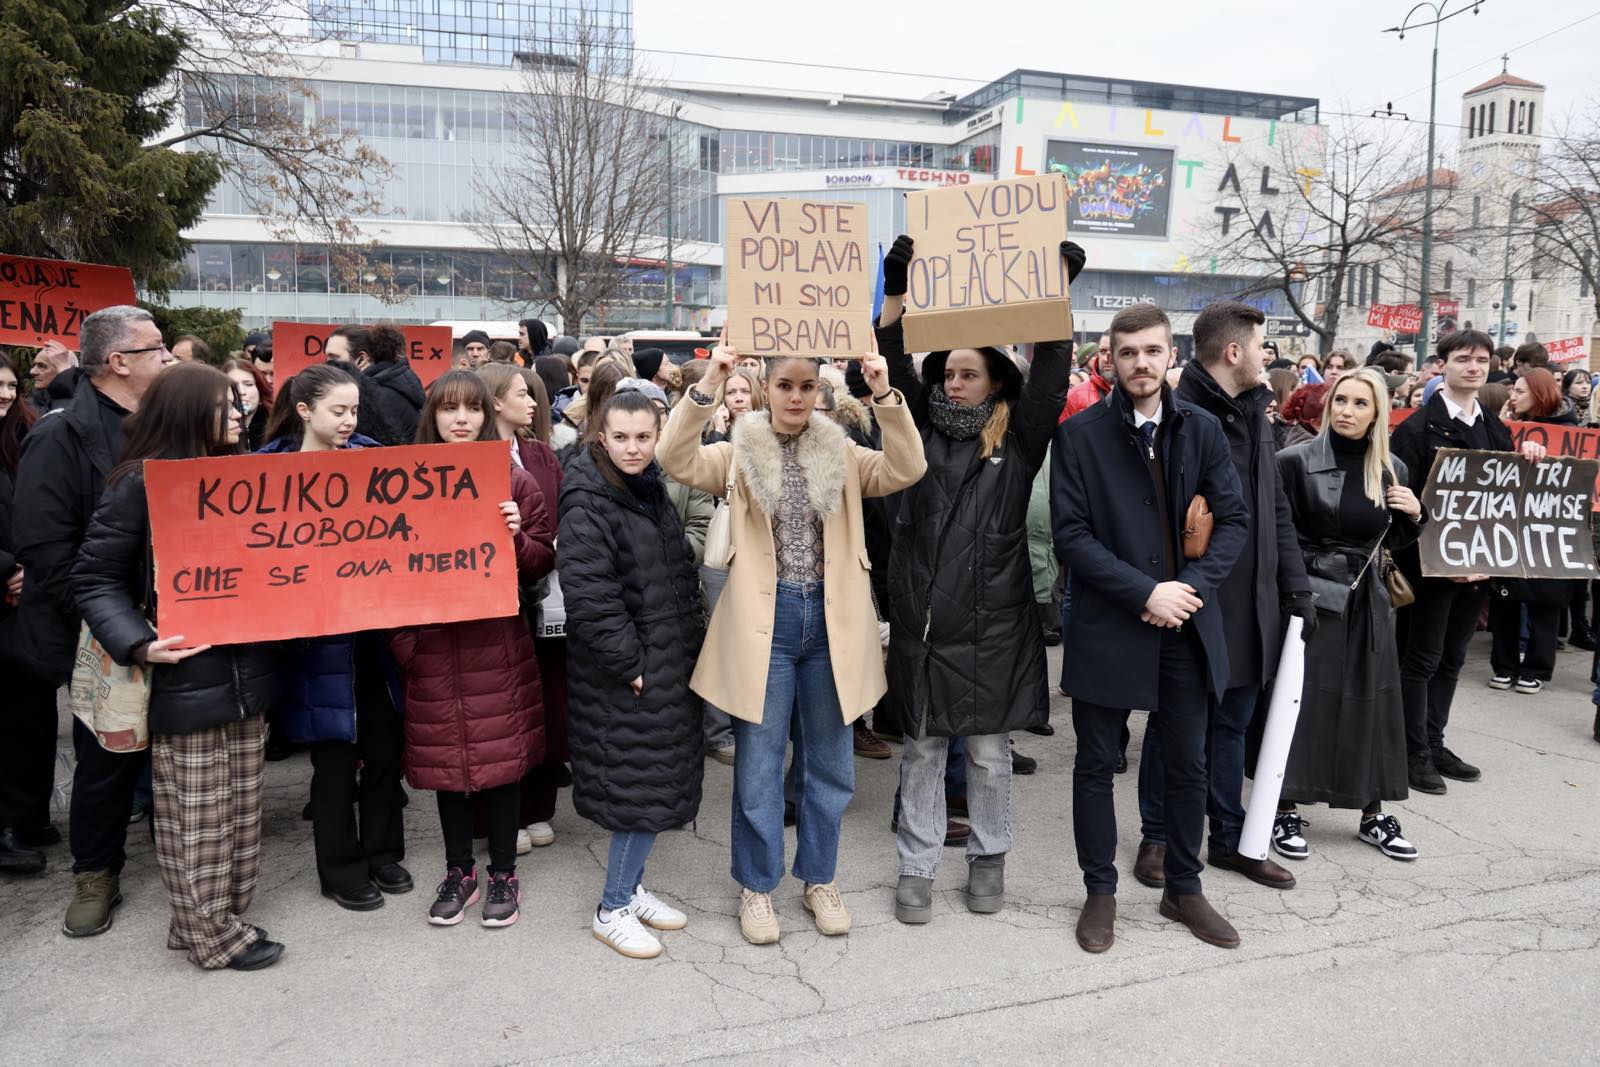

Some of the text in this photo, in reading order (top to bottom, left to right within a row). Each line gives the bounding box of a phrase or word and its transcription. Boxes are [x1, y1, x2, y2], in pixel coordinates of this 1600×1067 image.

[897, 169, 970, 185] TECHNO
[964, 181, 1056, 219] VODU
[743, 200, 854, 234] VI STE
[956, 221, 1019, 253] STE
[741, 236, 862, 275] POPLAVA
[0, 262, 51, 288] OJA
[754, 281, 850, 307] MI SMO
[752, 317, 851, 351] BRANA
[1437, 456, 1466, 483] NA
[1477, 458, 1520, 487] SVA
[1536, 462, 1572, 487] TRI
[198, 461, 479, 520] KOLIKO KOŠTA
[1432, 490, 1517, 521] JEZIKA
[1440, 521, 1594, 571] GADITE.
[173, 542, 497, 593] ČIME SE ONA MJERI?
[545, 624, 566, 635] BE
